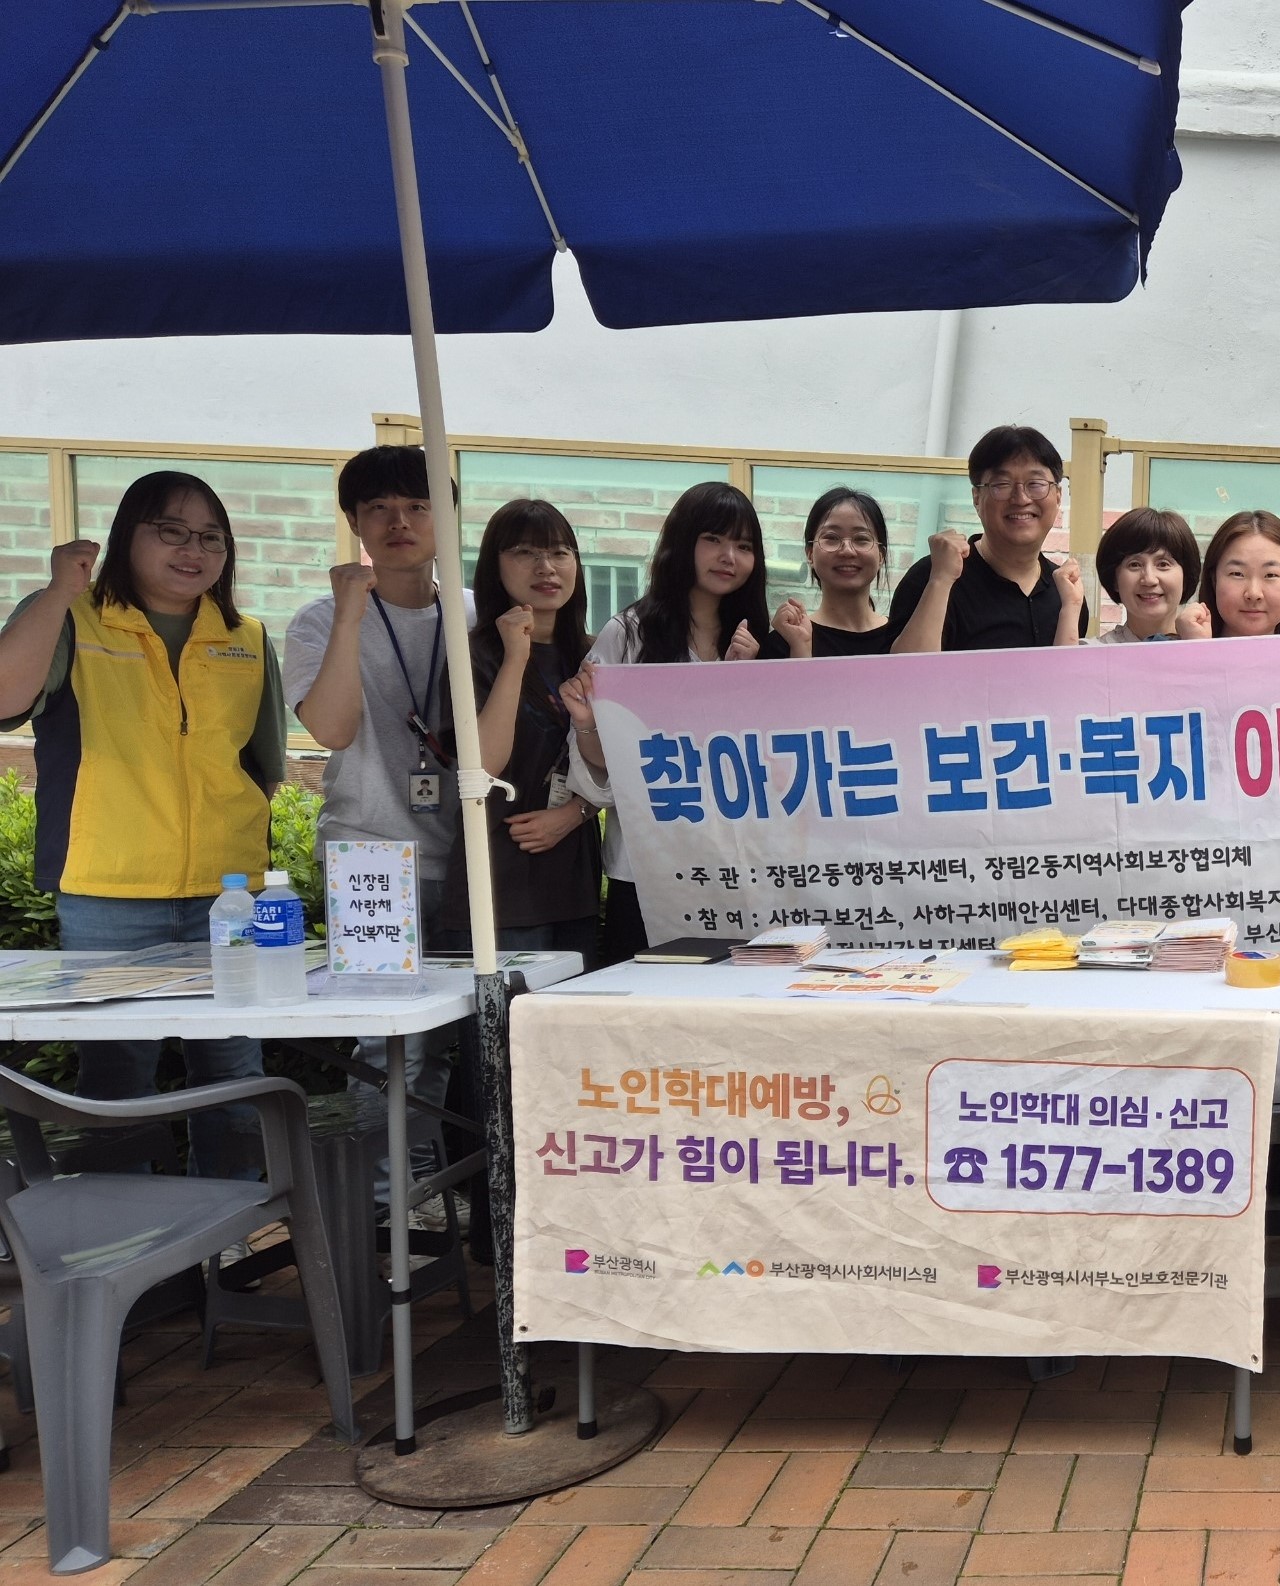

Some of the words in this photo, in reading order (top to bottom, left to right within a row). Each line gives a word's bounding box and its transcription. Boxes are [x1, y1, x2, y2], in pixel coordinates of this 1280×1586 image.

[639, 730, 900, 823] 찾아가는
[922, 709, 1206, 813] 보건·복지
[766, 858, 975, 888] 장림2동행정복지센터,
[985, 846, 1252, 882] 장림2동지역사회보장협의체
[349, 873, 390, 892] 신장림
[253, 906, 281, 914] CARI
[350, 899, 392, 918] 사랑채
[768, 906, 904, 930] 사하구보건소,
[912, 898, 1108, 926] 사하구치매안심센터,
[343, 924, 402, 943] 노인복지관
[577, 1068, 850, 1127] 노인학대예방,
[959, 1091, 1080, 1126] 노인학대
[535, 1131, 665, 1181] 신고가
[676, 1135, 759, 1184] 힘이
[773, 1140, 915, 1188] 됩니다.
[1000, 1143, 1235, 1195] 1577-1389
[592, 1253, 656, 1275] 부산광역시
[769, 1261, 938, 1284] 부산광역시사회서비스원
[1005, 1269, 1228, 1290] 부산광역시서부노인보호전문기관
